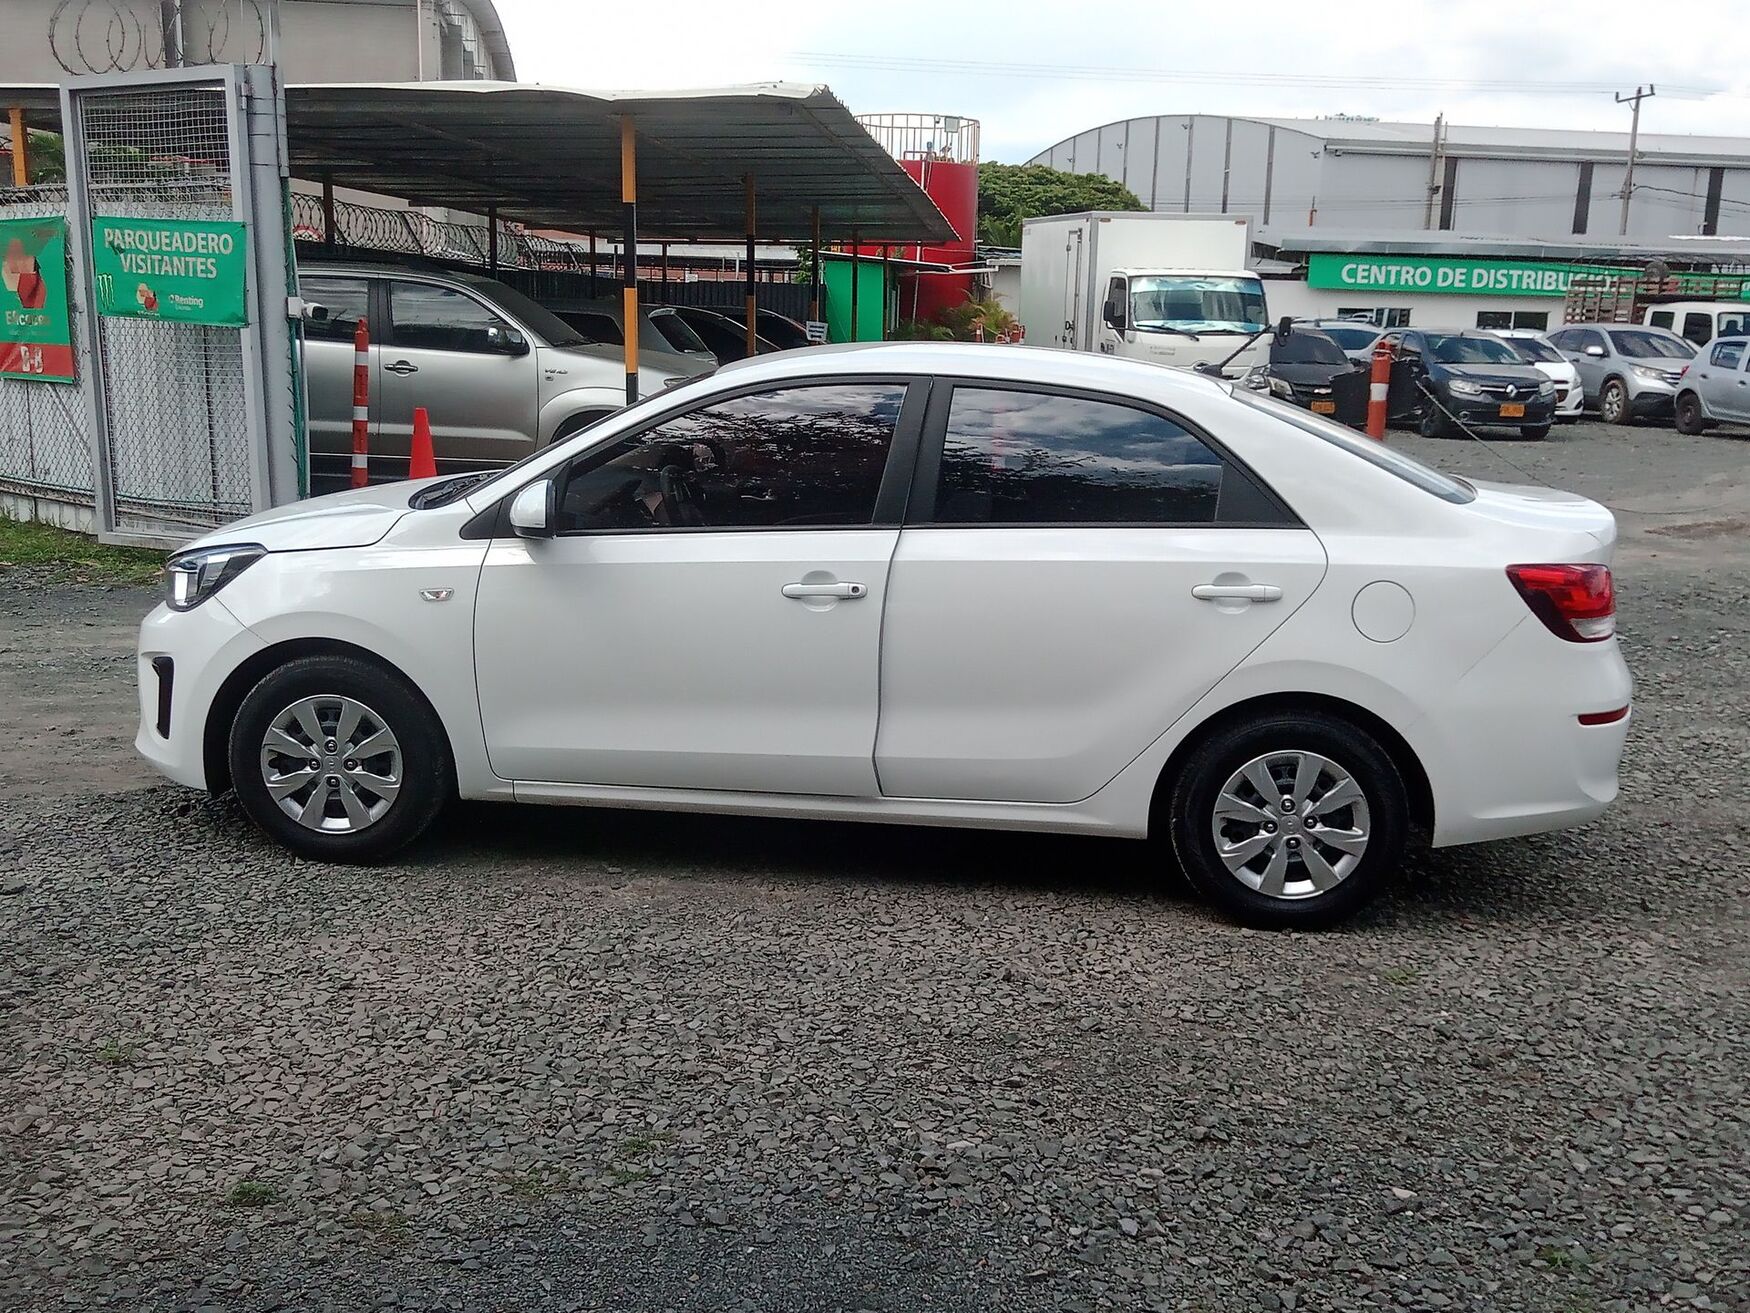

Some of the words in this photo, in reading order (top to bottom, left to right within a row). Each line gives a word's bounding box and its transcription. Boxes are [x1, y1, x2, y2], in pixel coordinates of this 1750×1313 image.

[104, 227, 233, 255] PARQUEADERO
[120, 252, 217, 279] VISITANTES
[1341, 263, 1432, 287] CENTRO
[1437, 267, 1467, 288] DE
